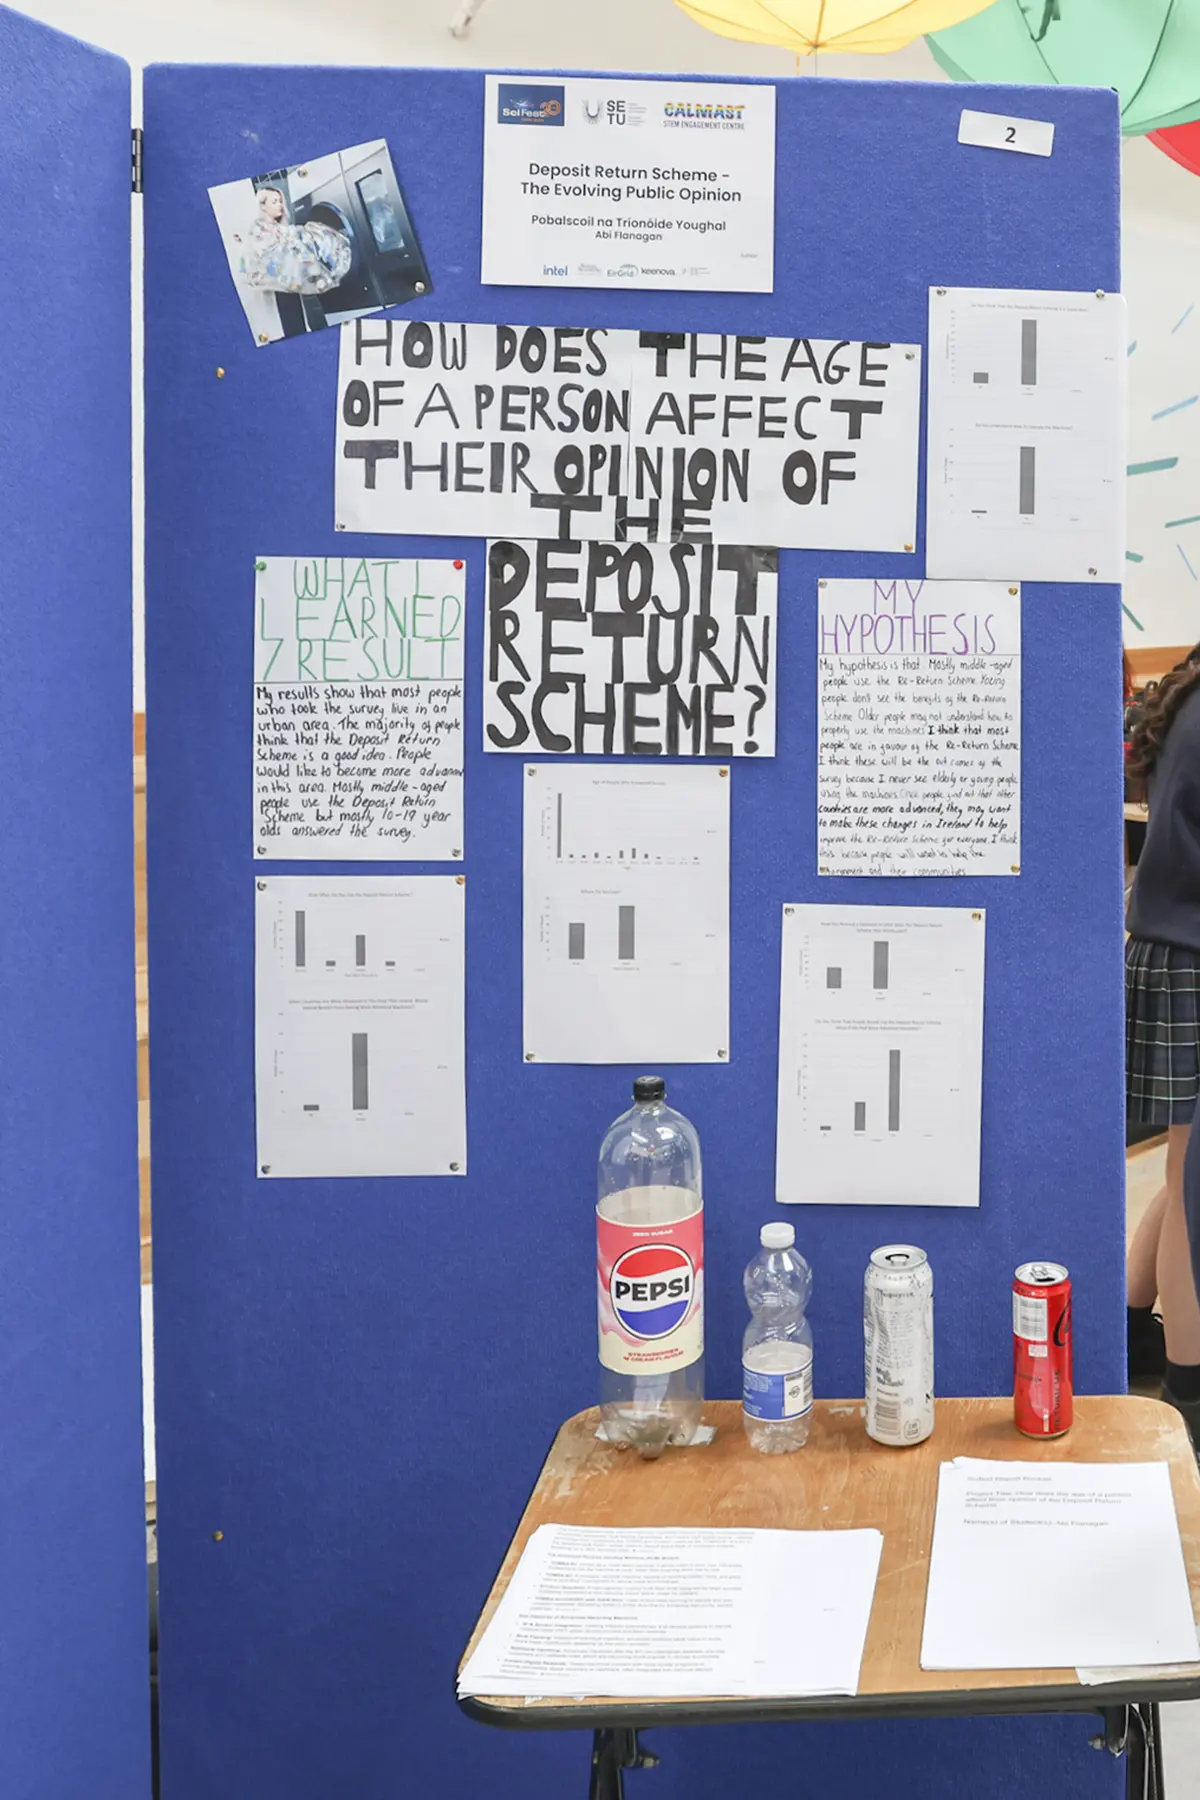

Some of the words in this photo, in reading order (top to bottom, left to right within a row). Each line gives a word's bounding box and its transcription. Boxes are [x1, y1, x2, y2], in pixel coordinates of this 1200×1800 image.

[664, 101, 745, 120] CALMAST
[681, 122, 717, 130] ENGAGEMENT
[719, 122, 745, 130] CENTRE
[1005, 127, 1016, 143] 2
[529, 163, 590, 179] Deposit
[595, 165, 648, 179] Return
[652, 167, 717, 181] Scheme
[521, 182, 550, 195] The
[554, 183, 621, 202] Evolving
[626, 186, 674, 199] Public
[679, 188, 741, 204] Opinion
[531, 215, 594, 227] Pobalscoil
[597, 219, 612, 228] na
[676, 219, 726, 233] Youghal
[595, 231, 612, 240] Abi
[614, 231, 662, 243] Flanagan
[543, 265, 568, 276] intel
[355, 320, 466, 370] HOW
[495, 325, 609, 377] DOES
[639, 331, 766, 382] THE
[781, 338, 891, 387] AGE
[343, 379, 405, 427] OF
[414, 383, 459, 429] A
[474, 384, 629, 433] PERSON
[645, 392, 884, 440] AFFECT
[344, 439, 538, 494] THEIR
[554, 443, 750, 502] OPINION
[782, 449, 856, 505] OF
[530, 493, 713, 543] THE
[294, 558, 400, 599] WHAT
[489, 540, 778, 619] DEPOSIT
[874, 579, 924, 615] MY
[261, 595, 461, 642] LEARNED
[821, 613, 996, 655] HYPOTHESIS
[490, 610, 770, 685] RETURN
[256, 686, 273, 704] My
[278, 685, 320, 700] results
[324, 685, 355, 699] show
[360, 685, 387, 698] that
[391, 684, 421, 698] most
[428, 684, 462, 704] people
[256, 703, 285, 715] who
[291, 703, 318, 715] took
[324, 702, 342, 714] the
[349, 704, 385, 720] survey
[391, 703, 409, 714] live
[415, 703, 427, 714] in
[433, 704, 448, 713] an
[486, 681, 767, 755] SCHEME?
[258, 718, 295, 731] urban
[337, 715, 359, 730] The
[365, 718, 415, 736] majority
[435, 717, 461, 734] people
[928, 725, 934, 735] I
[938, 724, 960, 734] think
[964, 725, 982, 734] that
[987, 726, 1010, 735] most
[257, 734, 289, 746] think
[295, 732, 319, 745] that
[324, 732, 343, 745] the
[349, 733, 390, 748] Deposit
[398, 733, 441, 745] Return
[257, 749, 298, 761] Scheme
[303, 751, 314, 761] is
[321, 751, 329, 761] a
[335, 750, 359, 767] good
[396, 748, 432, 764] People
[296, 763, 317, 776] like
[320, 765, 332, 776] to
[336, 763, 377, 776] become
[382, 766, 411, 776] more
[257, 781, 269, 793] in
[271, 780, 292, 793] this
[332, 779, 364, 797] Mostly
[260, 797, 289, 814] people
[302, 799, 319, 809] use
[328, 796, 345, 808] the
[352, 796, 395, 813] Deposit
[402, 795, 436, 808] Return
[264, 809, 305, 823] Scheme
[315, 809, 334, 821] but
[339, 809, 375, 827] mostly
[424, 811, 451, 828] year
[260, 824, 280, 836] olds
[292, 823, 343, 836] answered
[350, 824, 369, 837] the
[615, 1276, 690, 1301] PEPSI
